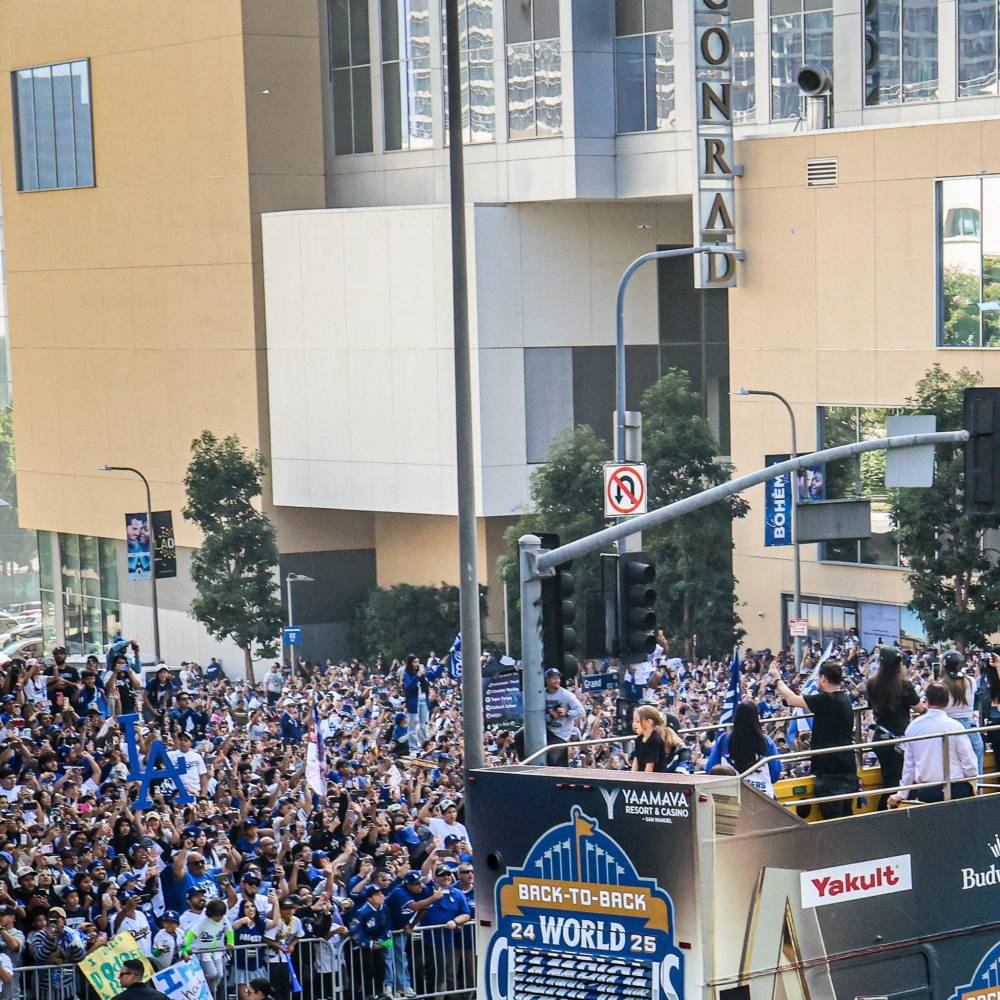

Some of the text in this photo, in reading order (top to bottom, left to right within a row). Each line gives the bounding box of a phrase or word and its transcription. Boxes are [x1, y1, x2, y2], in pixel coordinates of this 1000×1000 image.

[700, 0, 736, 283] ONRAD
[625, 806, 689, 818] RESORT & CASINO
[518, 884, 646, 911] BACK-TO-BACK
[811, 865, 899, 898] Yakult
[511, 914, 657, 953] 24 WORLD 25
